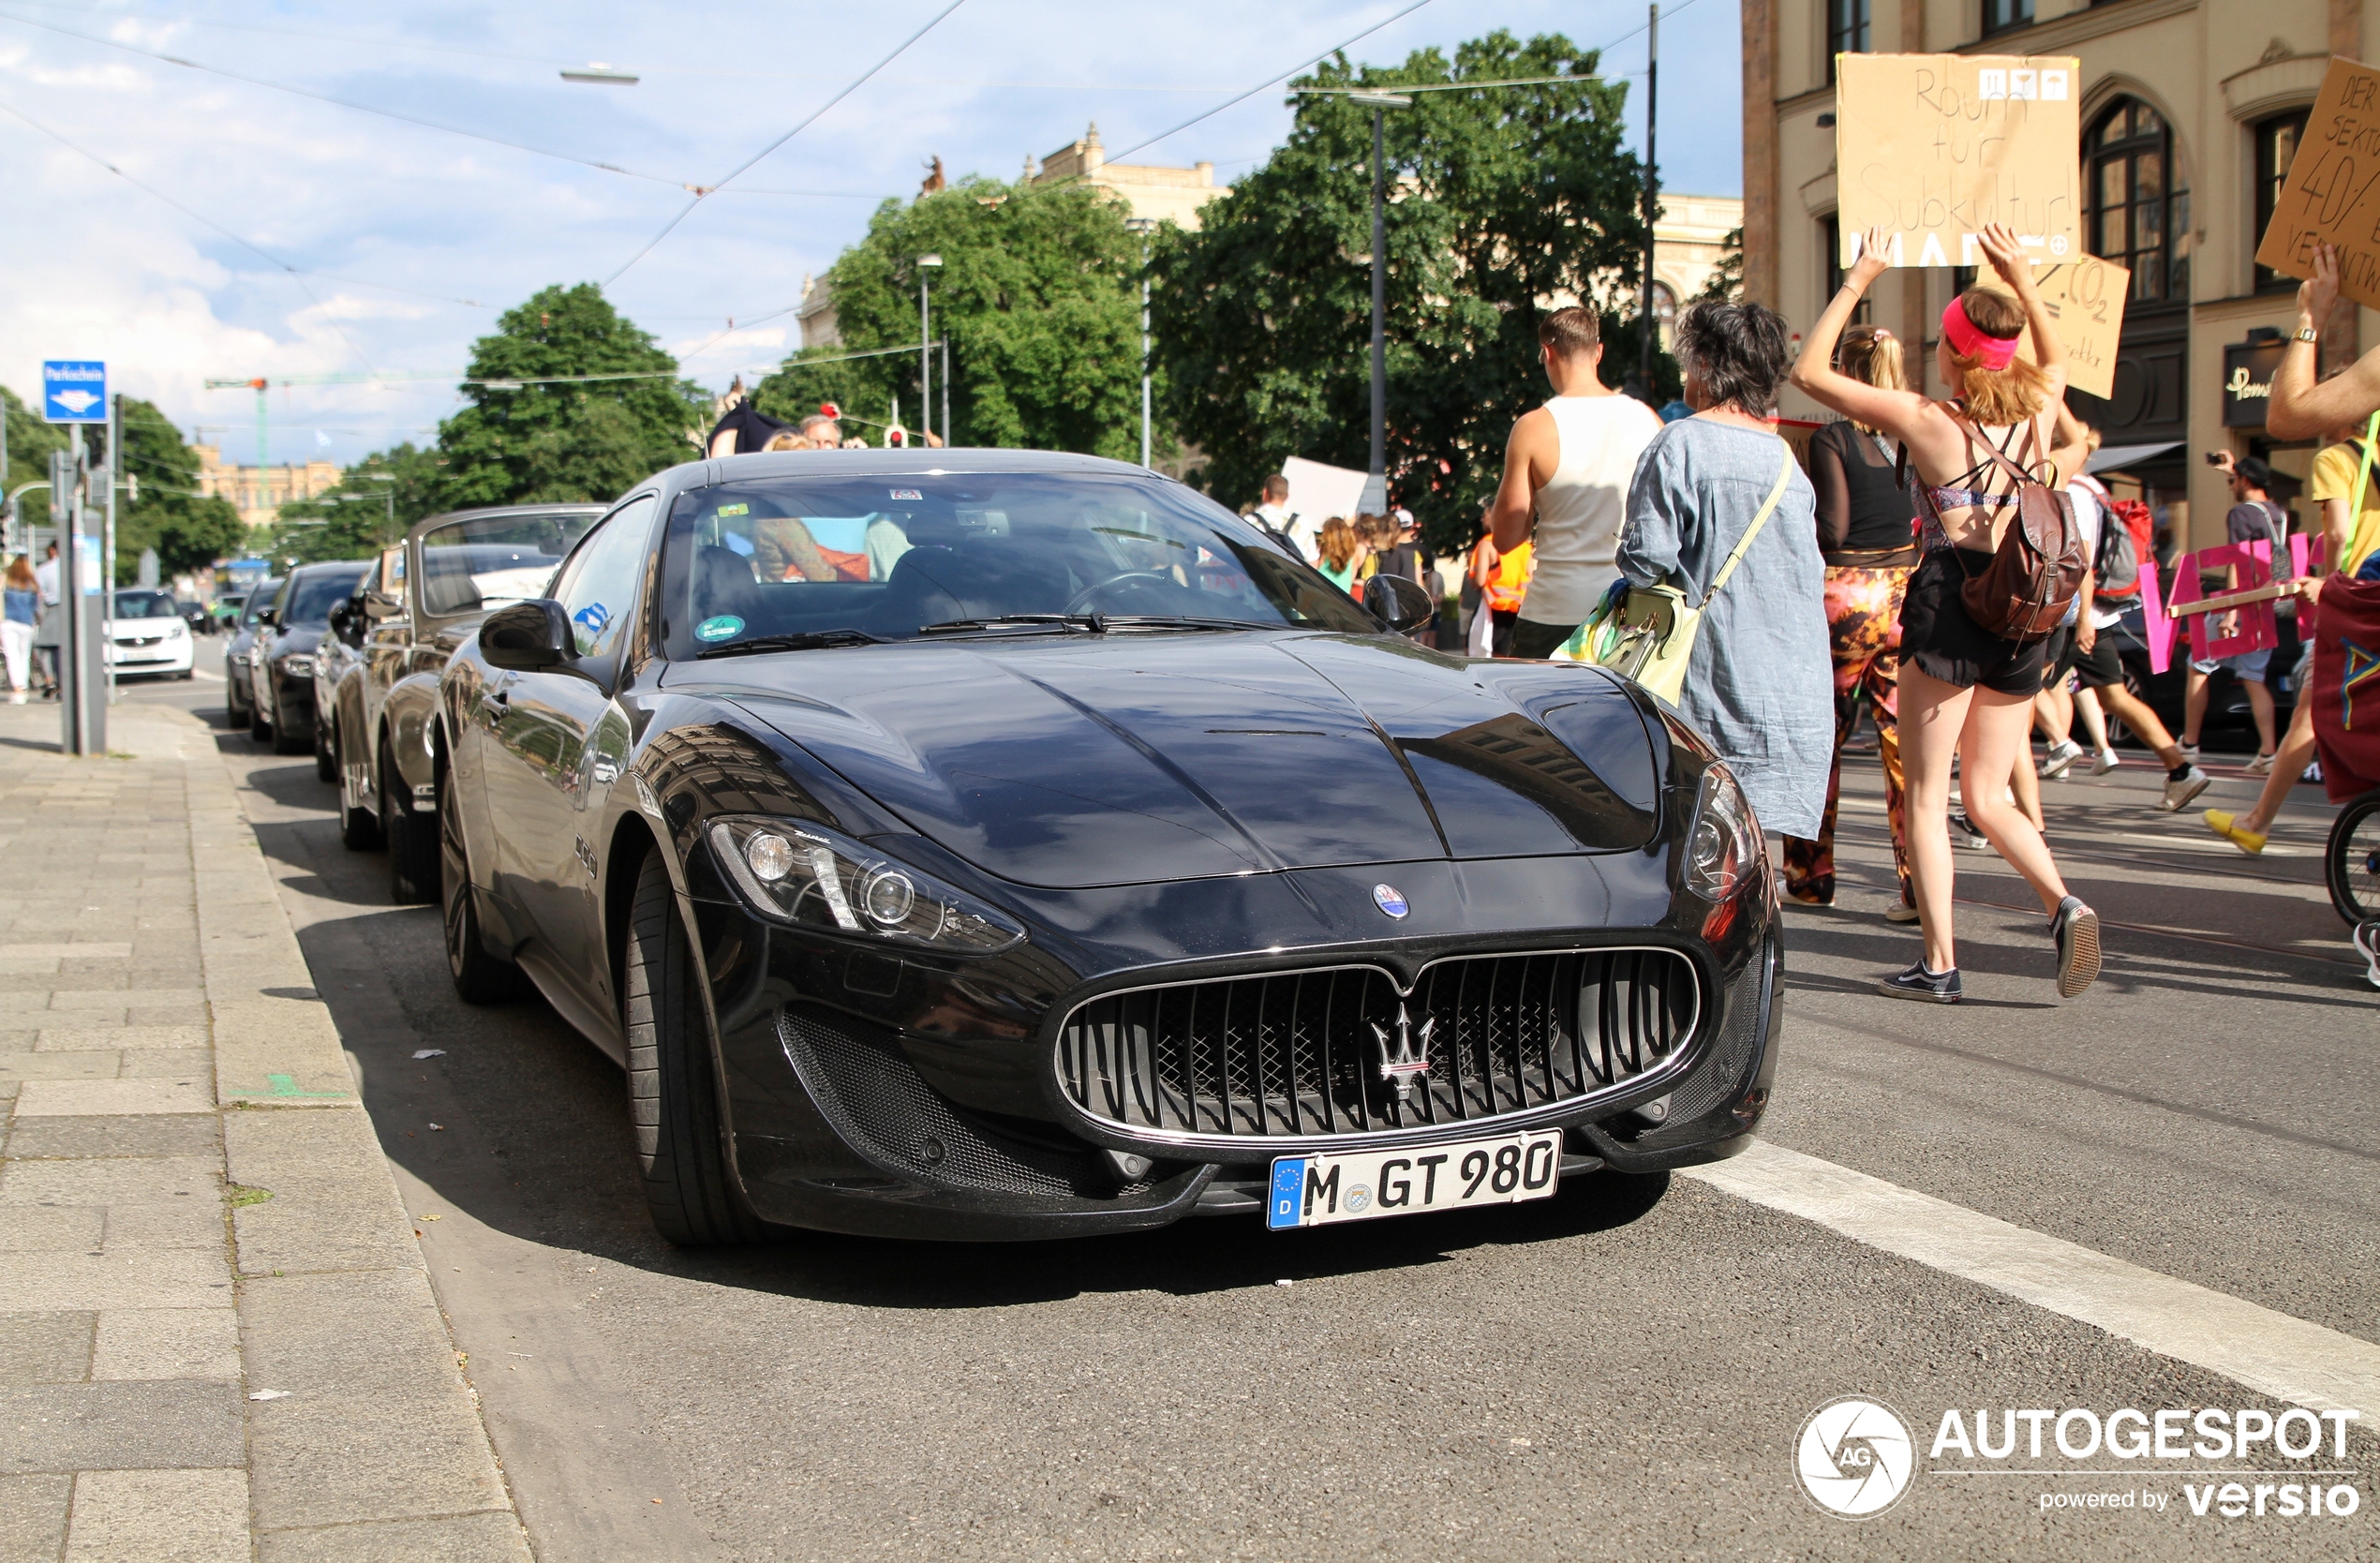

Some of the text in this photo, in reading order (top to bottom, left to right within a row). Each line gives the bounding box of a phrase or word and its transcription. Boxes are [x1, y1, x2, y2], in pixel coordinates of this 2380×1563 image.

[1915, 68, 2028, 123] Raum
[2340, 75, 2378, 112] DER
[1857, 162, 2073, 238] Subkultur!
[1303, 1164, 1340, 1216] M
[1377, 1154, 1449, 1208] GT
[1460, 1139, 1553, 1199] 980
[1279, 1199, 1291, 1215] D
